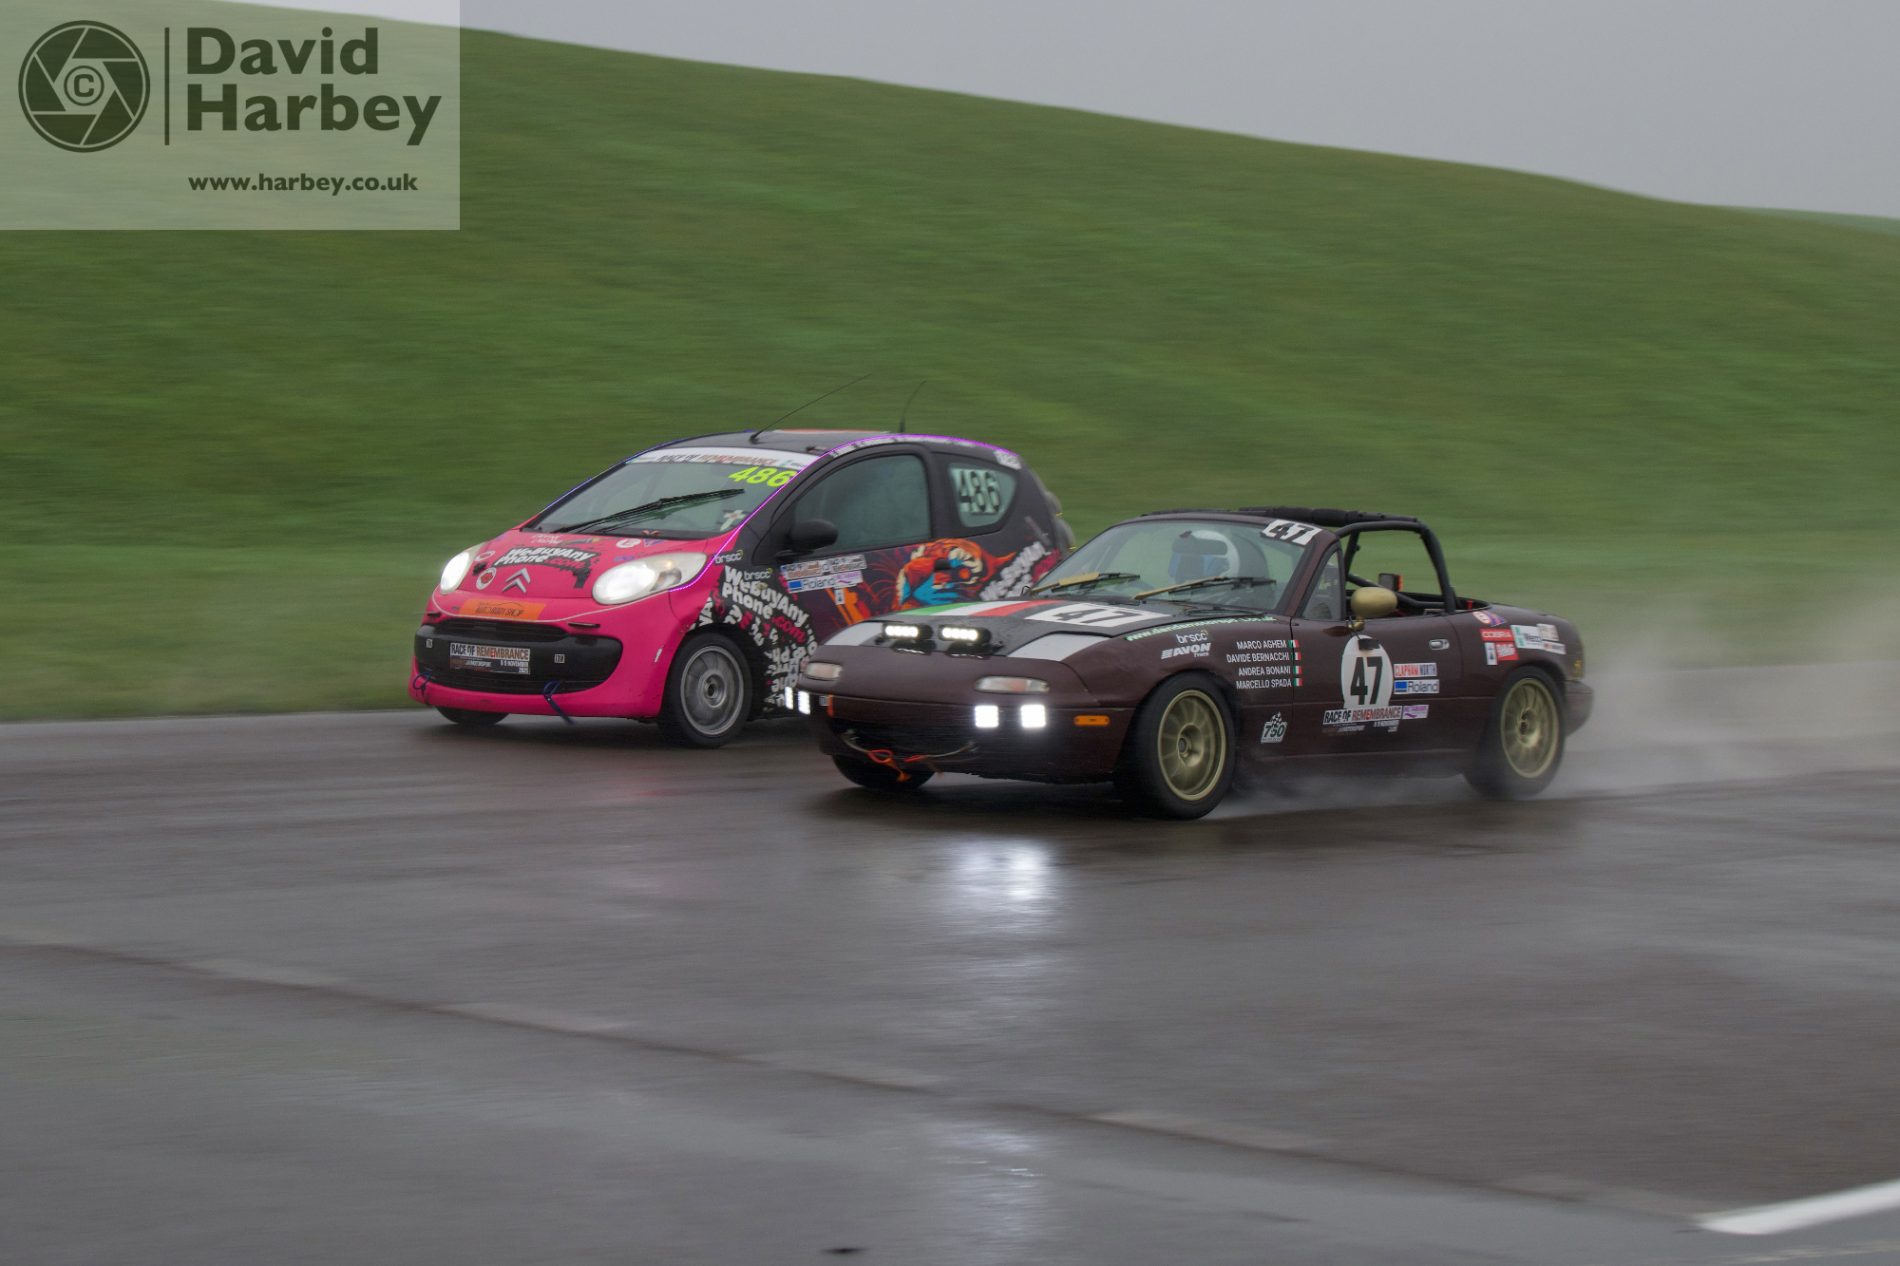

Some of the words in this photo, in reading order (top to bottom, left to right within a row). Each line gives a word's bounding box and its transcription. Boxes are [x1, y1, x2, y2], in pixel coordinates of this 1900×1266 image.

[728, 465, 797, 487] 486
[951, 468, 1001, 513] 486
[1269, 522, 1315, 543] 47
[714, 552, 742, 564] brscc
[744, 569, 771, 580] brscc
[722, 582, 773, 619] Phone
[1053, 608, 1142, 624] 47
[1175, 630, 1206, 644] brscc
[1171, 643, 1211, 655] AVON
[1236, 640, 1261, 650] MARCO
[1263, 639, 1287, 649] AGHEM
[451, 643, 466, 656] RACE
[467, 645, 476, 657] OF
[476, 646, 529, 661] REMEMBRANCE
[1226, 653, 1251, 663] DAVIDE
[1252, 652, 1290, 662] BERNACCHI
[1238, 666, 1265, 676] ANDREA
[1266, 665, 1291, 675] BONANI
[1235, 680, 1270, 690] MARCELLO
[1271, 678, 1293, 688] SPADA
[1350, 656, 1383, 705] 47
[1407, 681, 1438, 692] Roland
[1324, 710, 1341, 723] RACE
[1342, 710, 1352, 721] OF
[1352, 707, 1401, 721] REMEMBRANCE
[1264, 724, 1285, 738] 750
